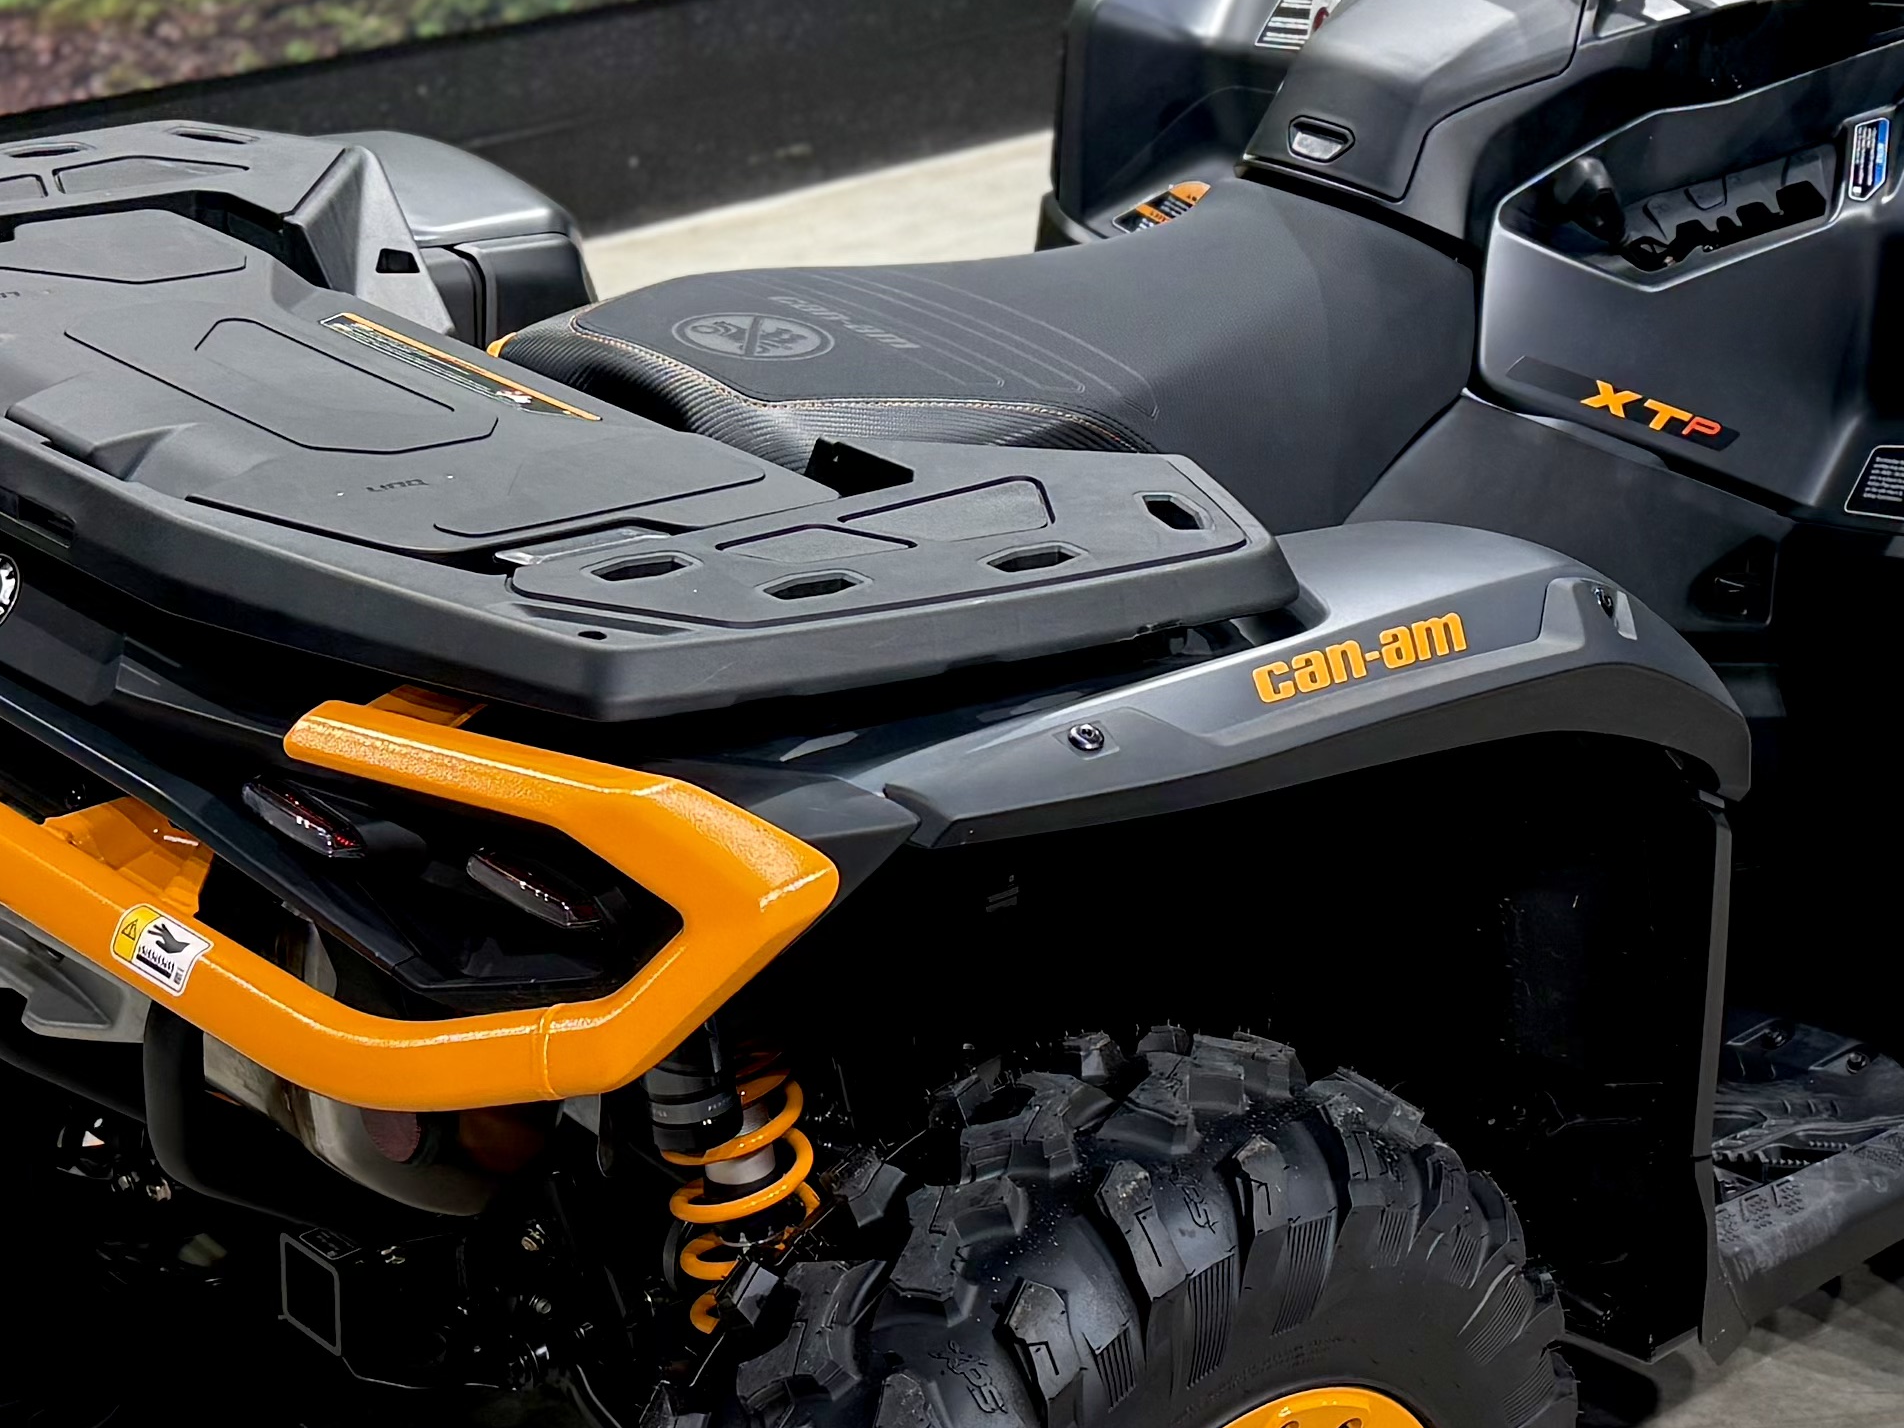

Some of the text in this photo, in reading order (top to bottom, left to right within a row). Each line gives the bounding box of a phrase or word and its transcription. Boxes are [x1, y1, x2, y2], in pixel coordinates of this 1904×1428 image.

[767, 295, 922, 350] can-am
[1251, 611, 1468, 705] can-am
[928, 1340, 1009, 1414] XPS
